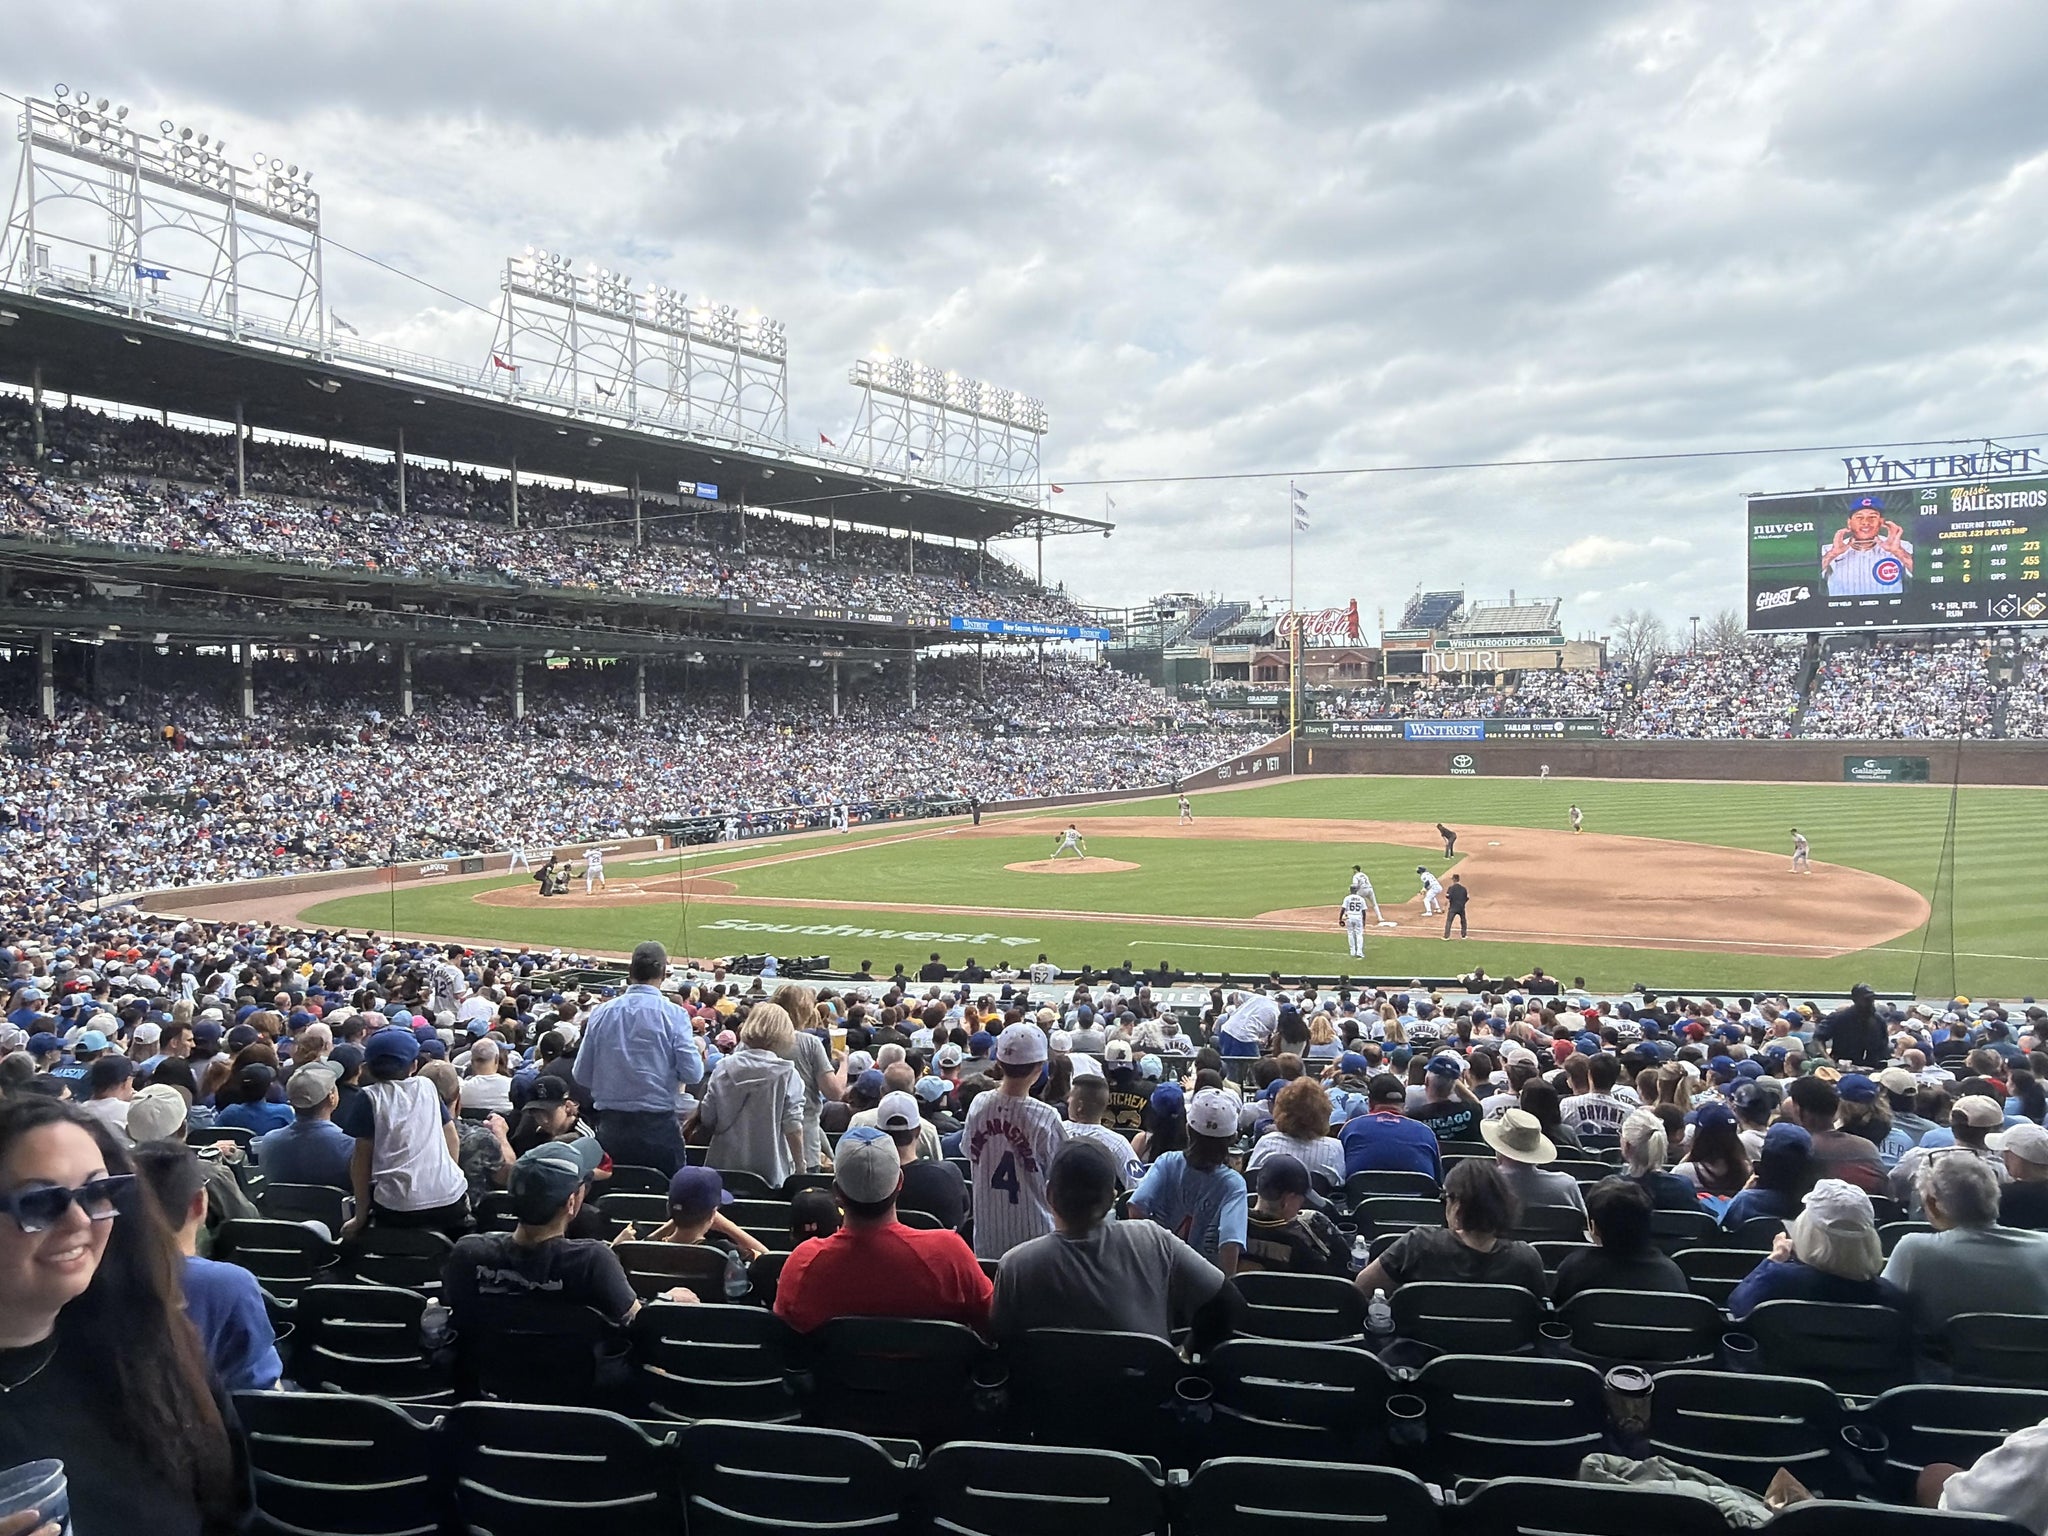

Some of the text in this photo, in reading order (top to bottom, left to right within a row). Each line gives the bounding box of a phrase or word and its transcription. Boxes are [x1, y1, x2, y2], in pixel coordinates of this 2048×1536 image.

[1841, 448, 2040, 484] WINTRUST
[1921, 488, 1937, 500] 25
[1952, 490, 2047, 512] BALLESTEROS
[1920, 505, 1938, 515] DH
[1753, 521, 1814, 535] nuveen
[1939, 530, 1967, 539] CAREER
[1960, 545, 1973, 554] 33
[2020, 541, 2040, 551] .273
[1963, 559, 1971, 569] 2
[1963, 574, 1971, 583] 6
[2020, 570, 2040, 580] .779
[1756, 587, 1799, 608] GHOST
[2001, 605, 2009, 613] K
[1003, 623, 1013, 631] New
[1450, 637, 1551, 648] WRIGLEYROOFTOPS.COM
[1305, 726, 1329, 734] Harvey
[1361, 724, 1393, 732] CHANDLER
[1410, 723, 1480, 736] WINTRUST
[1266, 757, 1279, 772] YETI
[1851, 767, 1892, 776] Gallagher
[420, 863, 449, 875] MARQUEE
[1349, 901, 1361, 911] 65
[698, 919, 1000, 945] Southwest
[1034, 972, 1048, 983] 62
[1423, 1110, 1472, 1128] HICAGO
[1578, 1105, 1625, 1124] BRYANT
[991, 1150, 1019, 1204] 4
